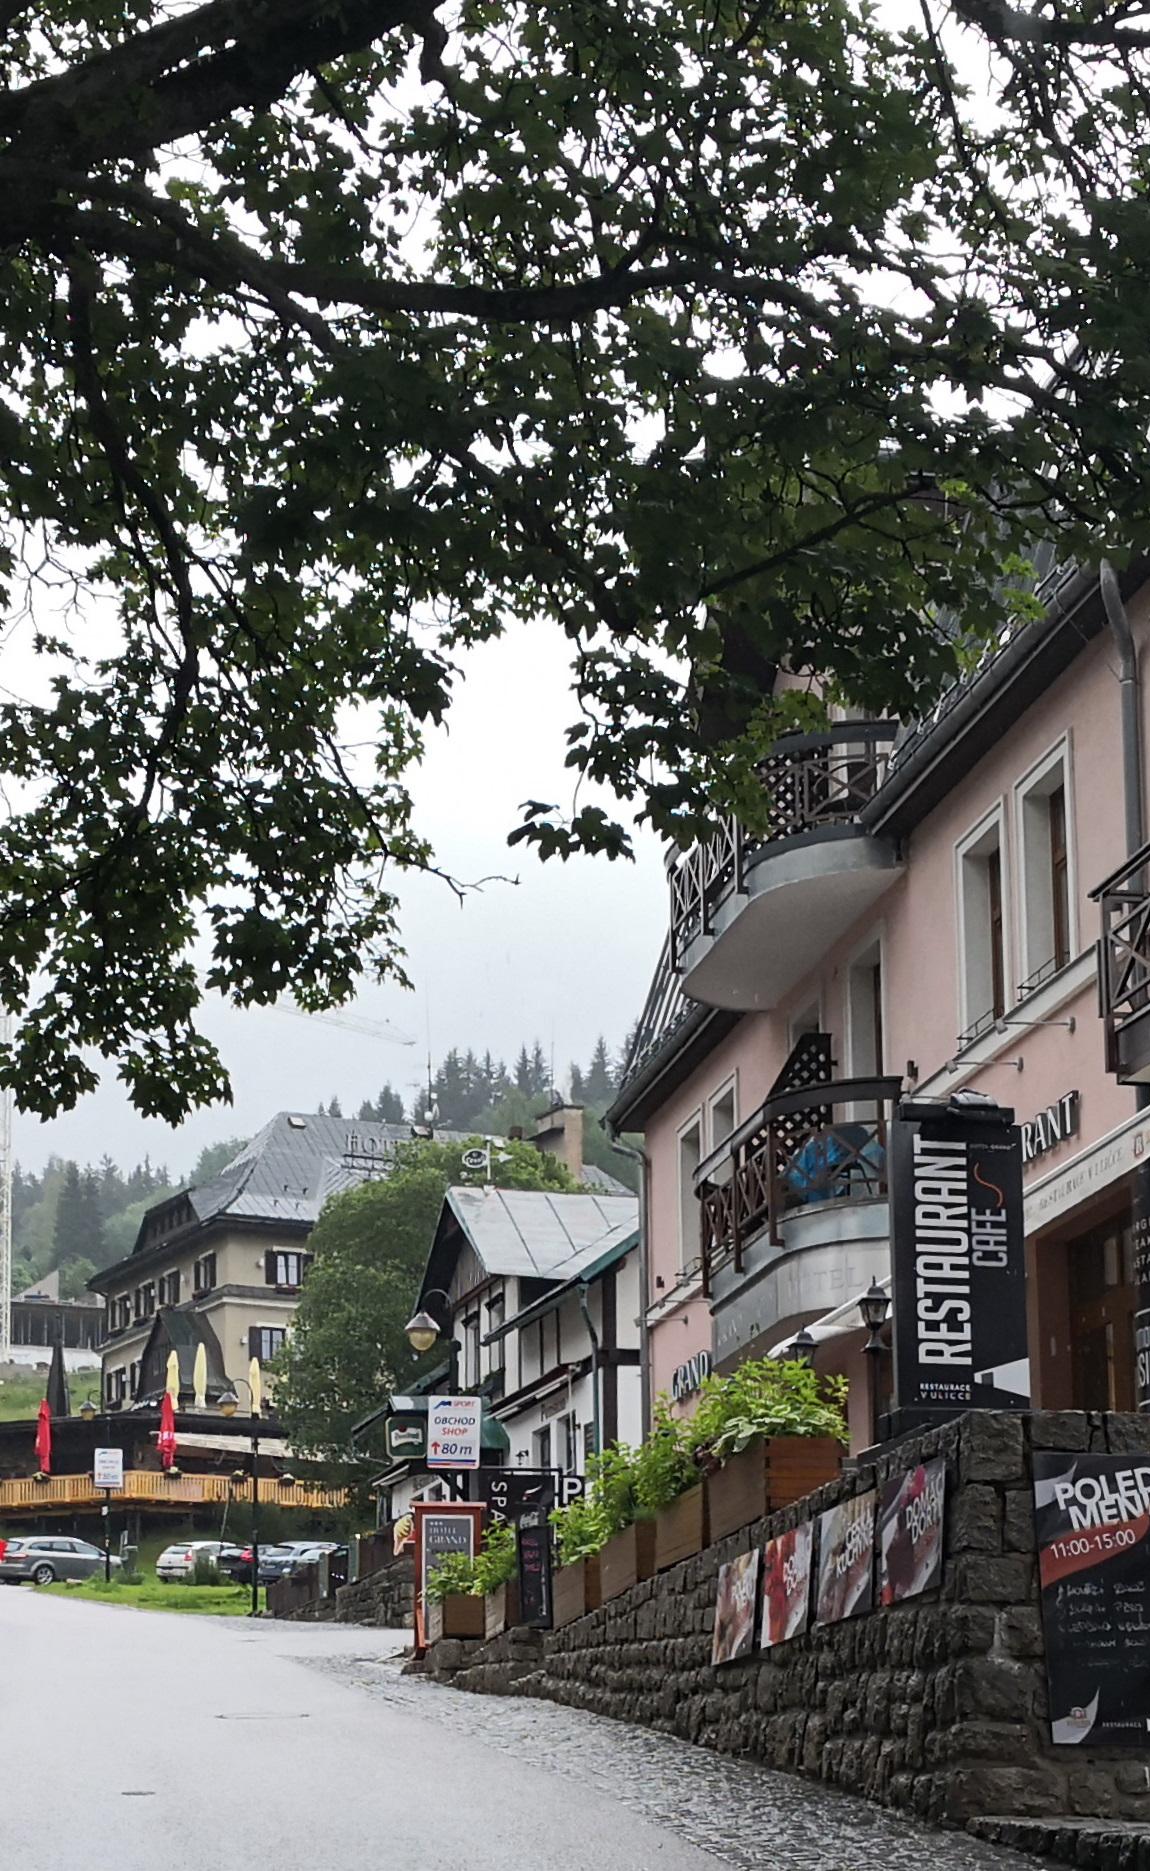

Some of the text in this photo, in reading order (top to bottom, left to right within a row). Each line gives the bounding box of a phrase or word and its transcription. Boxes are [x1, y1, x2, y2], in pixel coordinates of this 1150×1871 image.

[971, 1208, 1007, 1267] CAFE
[914, 1134, 972, 1365] RESTAURANT
[671, 1350, 712, 1400] GRAND
[919, 1383, 971, 1391] RESTAURACE
[434, 1416, 476, 1425] OBCHOD
[441, 1427, 468, 1437] SHOP
[441, 1443, 473, 1455] 80 m
[1050, 1528, 1136, 1559] 11:00-15:00
